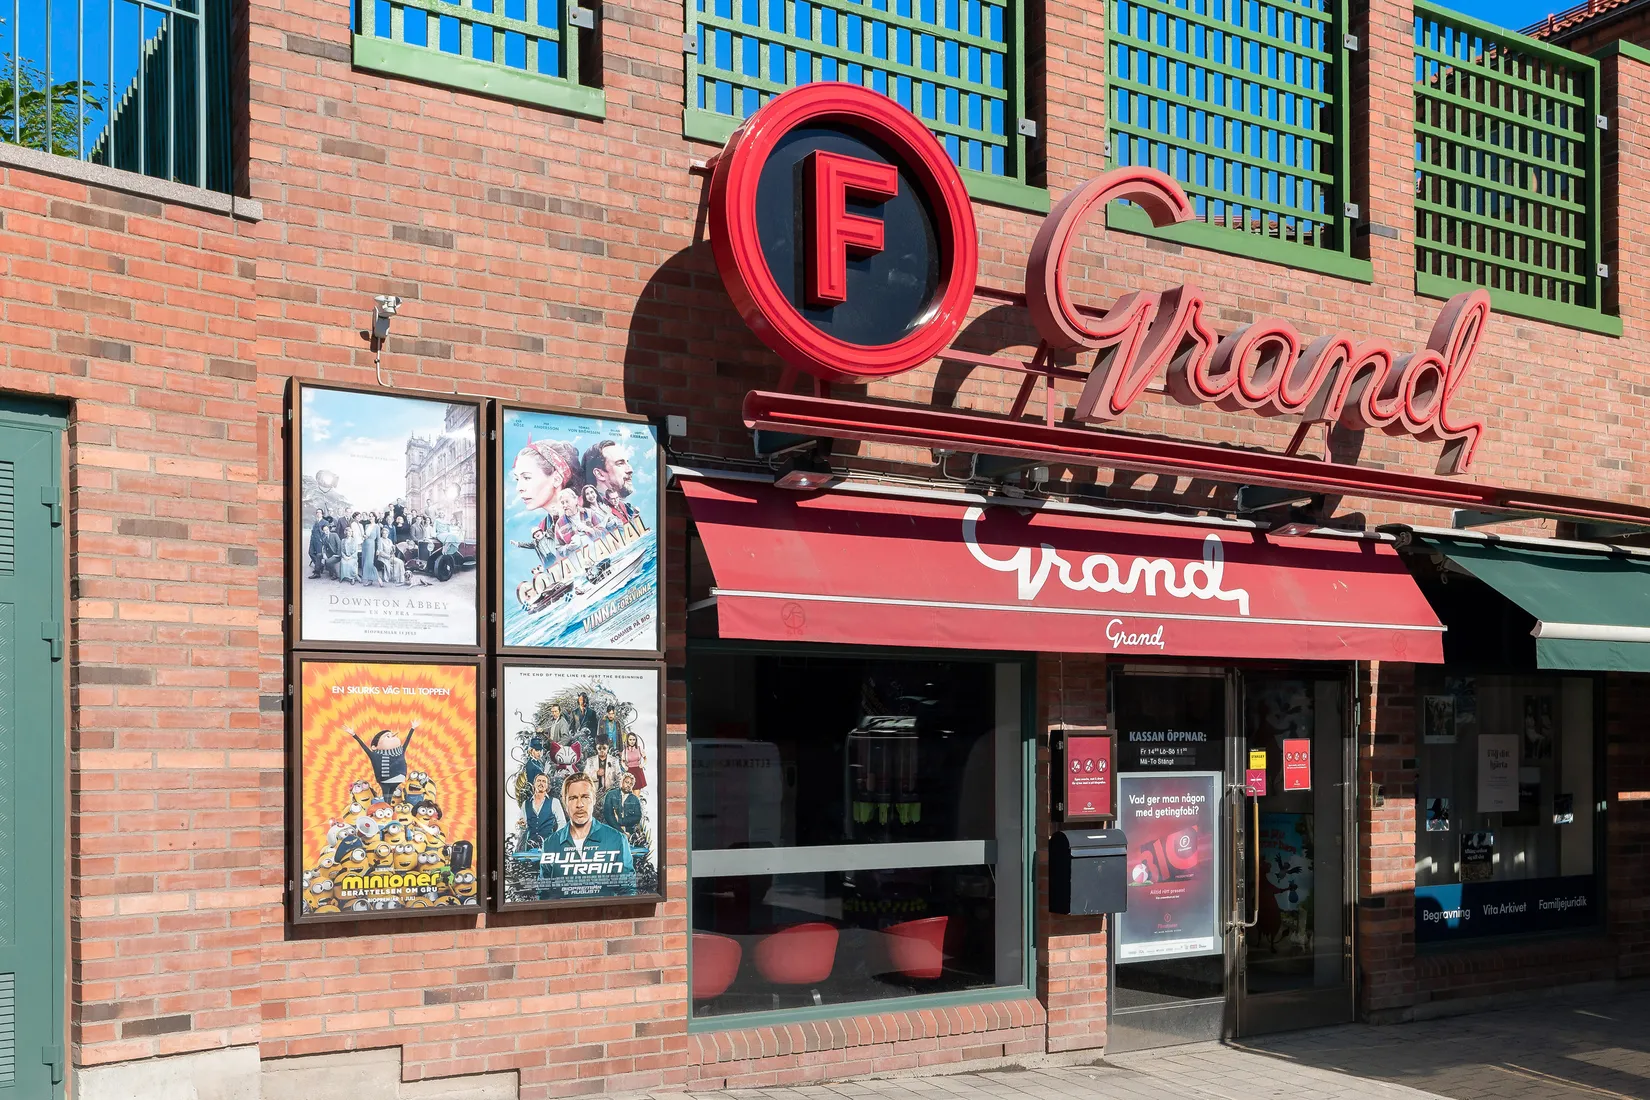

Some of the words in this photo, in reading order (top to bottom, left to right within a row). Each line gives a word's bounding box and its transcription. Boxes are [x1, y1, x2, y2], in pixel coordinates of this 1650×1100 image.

[803, 150, 899, 307] F
[1027, 166, 1491, 475] Grand
[575, 515, 651, 568] KANAL
[962, 503, 1250, 616] Grand
[330, 594, 400, 608] DOWNTON
[406, 599, 449, 610] ABBEY
[583, 600, 616, 633] VINNA
[610, 625, 633, 643] KOMMER
[633, 619, 641, 628] PÅ
[641, 614, 651, 624] BIO
[1106, 618, 1165, 650] Grand
[332, 686, 344, 694] EN
[347, 686, 380, 695] SKURKS
[382, 685, 400, 694] VÄG
[418, 687, 450, 696] TOPPEN
[1129, 732, 1164, 741] KASSAN
[1167, 729, 1207, 741] ÖPPNAR:
[1129, 794, 1145, 804] Vad
[1147, 796, 1160, 806] ger
[1182, 793, 1205, 804] någon
[1136, 807, 1153, 817] med
[1155, 806, 1199, 818] getingfobi?
[540, 851, 620, 864] BULLET
[560, 862, 623, 875] TRAIN
[341, 888, 402, 897] BERÄTTELSEN
[1483, 904, 1499, 916] Vita
[1499, 902, 1527, 915] Arkivet
[1539, 895, 1588, 912] Familjejuridik
[1423, 906, 1471, 923] Begravning
